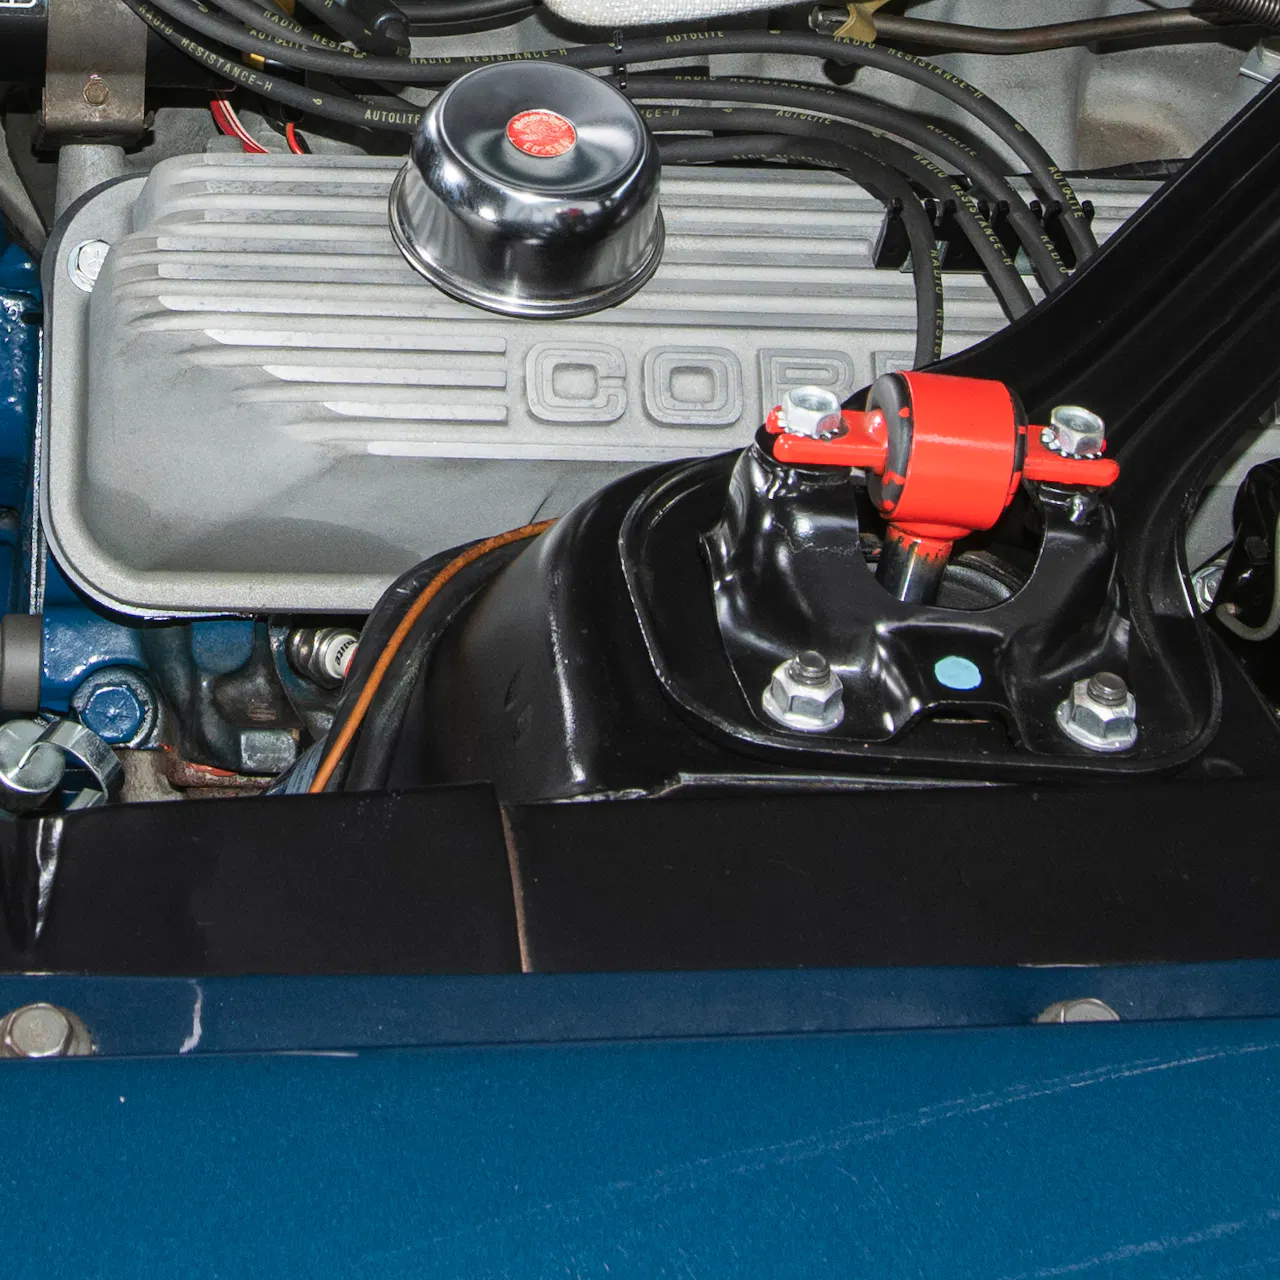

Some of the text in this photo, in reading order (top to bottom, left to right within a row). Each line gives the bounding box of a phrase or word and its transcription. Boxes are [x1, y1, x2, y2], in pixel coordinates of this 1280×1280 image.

[263, 10, 303, 34] RADIO
[665, 30, 724, 45] AUTOLITE
[180, 37, 273, 93] RESISTANCE-H
[887, 47, 985, 100] RESISTANCE-H
[1047, 165, 1085, 219] AUTOLITE
[949, 183, 1015, 267] RESISTANCE-H
[1040, 234, 1069, 274] RADIO
